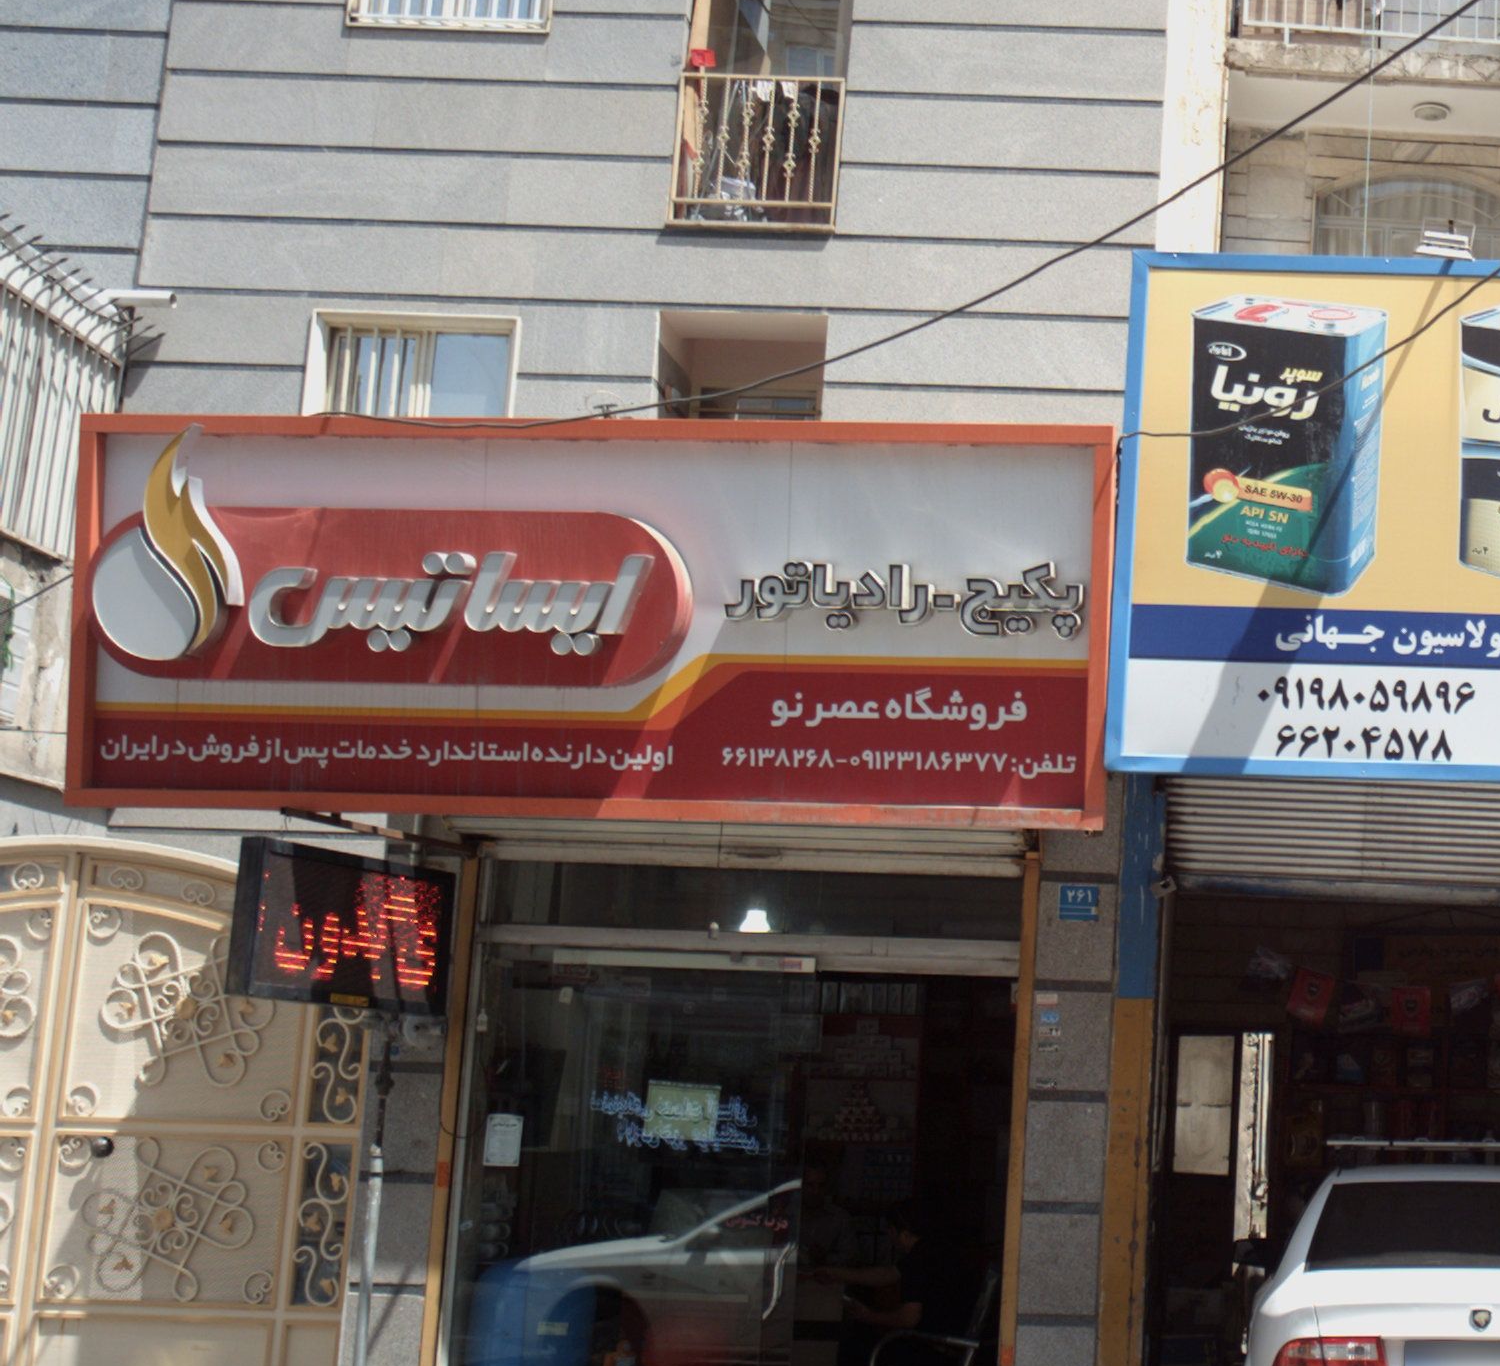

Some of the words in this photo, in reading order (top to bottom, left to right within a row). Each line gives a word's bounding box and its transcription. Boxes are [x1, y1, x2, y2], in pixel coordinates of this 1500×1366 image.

[1280, 367, 1323, 384] سوپر
[1210, 365, 1320, 420] رونیا
[1245, 485, 1267, 498] SAE
[1241, 506, 1265, 519] API
[1268, 510, 1289, 523] SN
[249, 551, 656, 656] ایساتیس
[1276, 614, 1385, 653] جهانی
[1258, 675, 1476, 713] ۰۹۱۹۸۰۵۹۸۹۶
[770, 692, 803, 727] نو
[806, 701, 879, 729] عصر
[885, 689, 1027, 730] فروشگاه
[100, 734, 157, 761] ایران
[156, 739, 187, 761] در
[188, 734, 259, 763] فروش
[259, 738, 280, 763] از
[284, 744, 328, 769] پس
[332, 738, 413, 761] خدمات
[416, 740, 528, 766] استاندارد
[530, 743, 607, 769] دارنده
[1276, 726, 1453, 762] ۶۶۲۰۴۵۷۸
[609, 745, 673, 771] اولین
[1066, 889, 1092, 903] ۲۶۱
